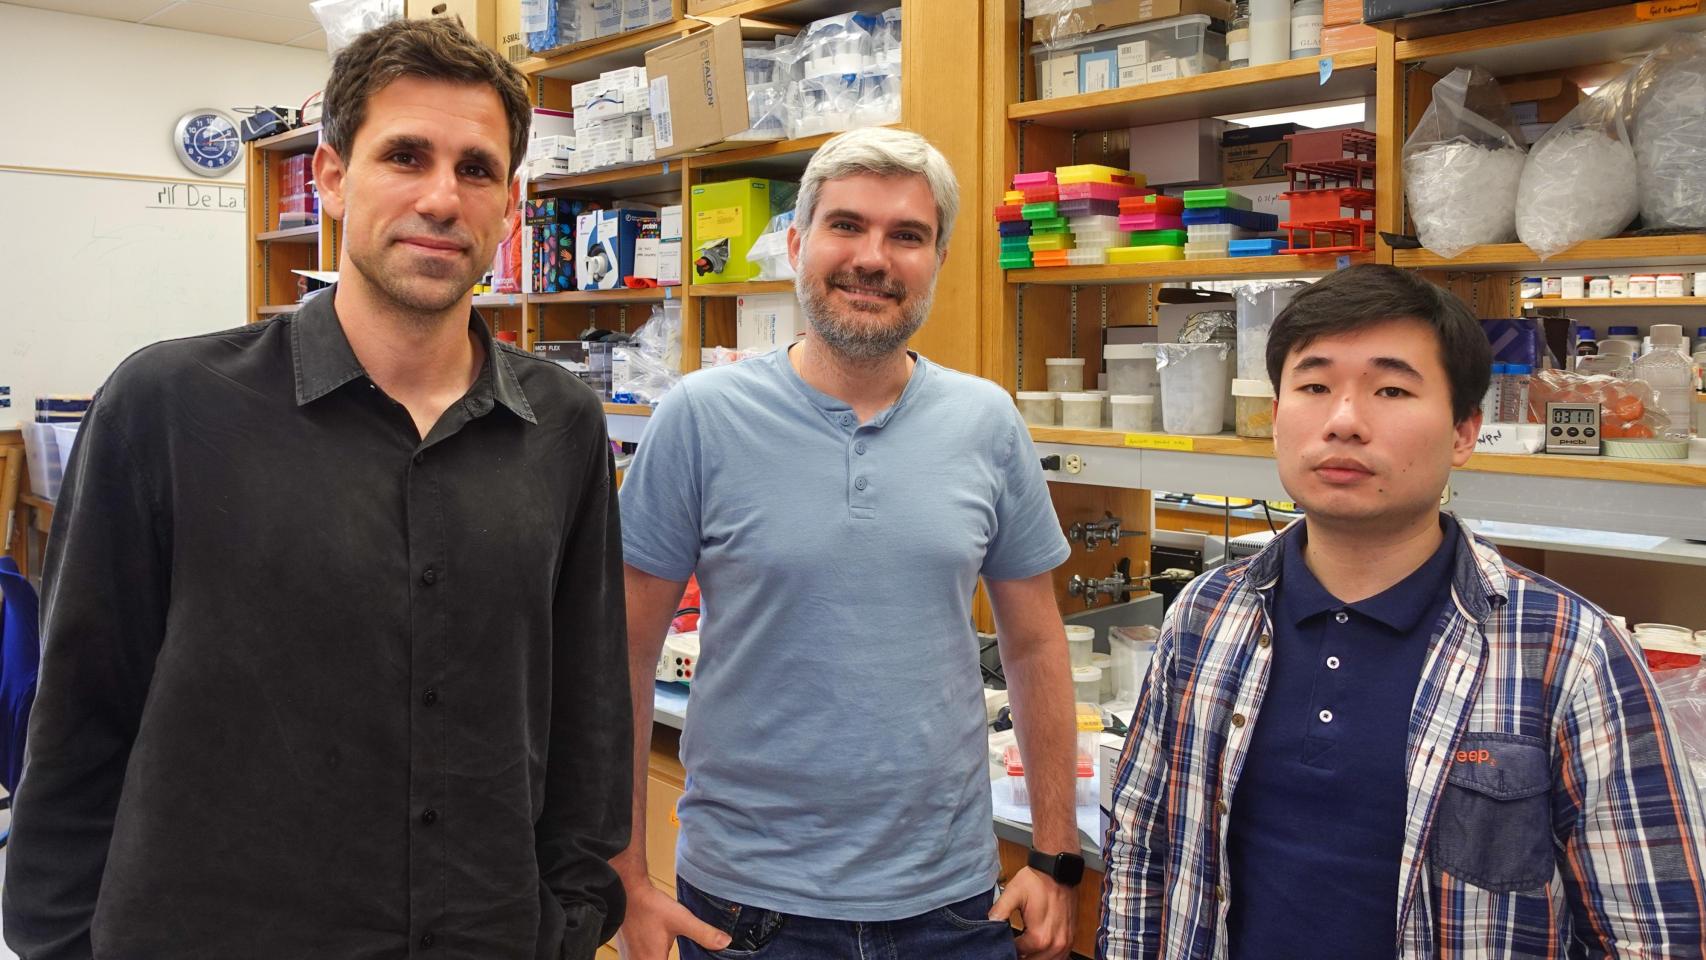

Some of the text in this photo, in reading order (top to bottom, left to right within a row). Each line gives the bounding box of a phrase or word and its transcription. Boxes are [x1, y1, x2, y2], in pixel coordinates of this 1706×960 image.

[703, 59, 714, 106] FALCON
[187, 185, 211, 207] De
[1456, 749, 1490, 764] eep
